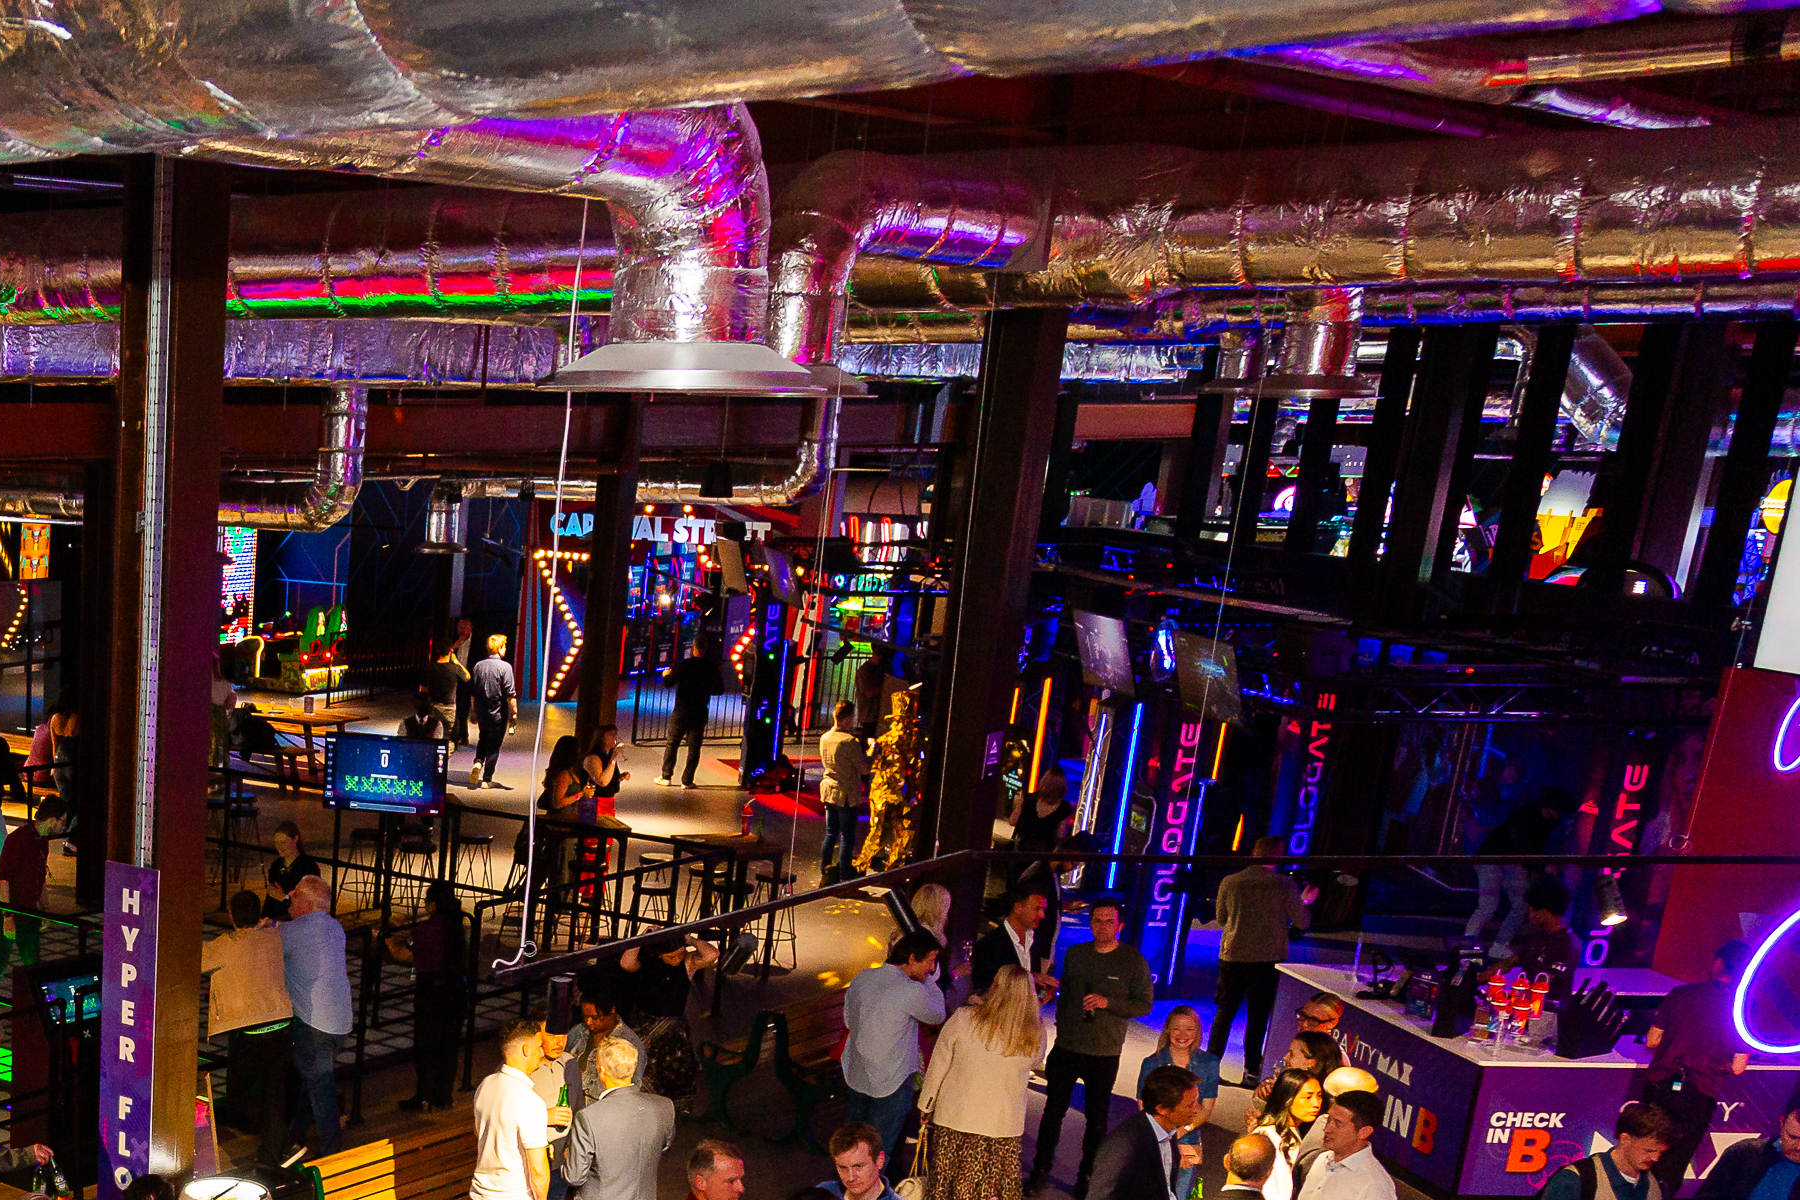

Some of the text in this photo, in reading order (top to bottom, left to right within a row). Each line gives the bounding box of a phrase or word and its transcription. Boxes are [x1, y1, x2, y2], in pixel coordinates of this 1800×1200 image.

[673, 518, 771, 544] STRET
[1289, 693, 1336, 869] OLOGATE
[118, 888, 140, 1063] HYPER
[1332, 1028, 1414, 1087] RAVITY MAX
[1489, 1111, 1567, 1129] CHECK
[1486, 1128, 1511, 1144] IN
[1505, 1128, 1552, 1173] B
